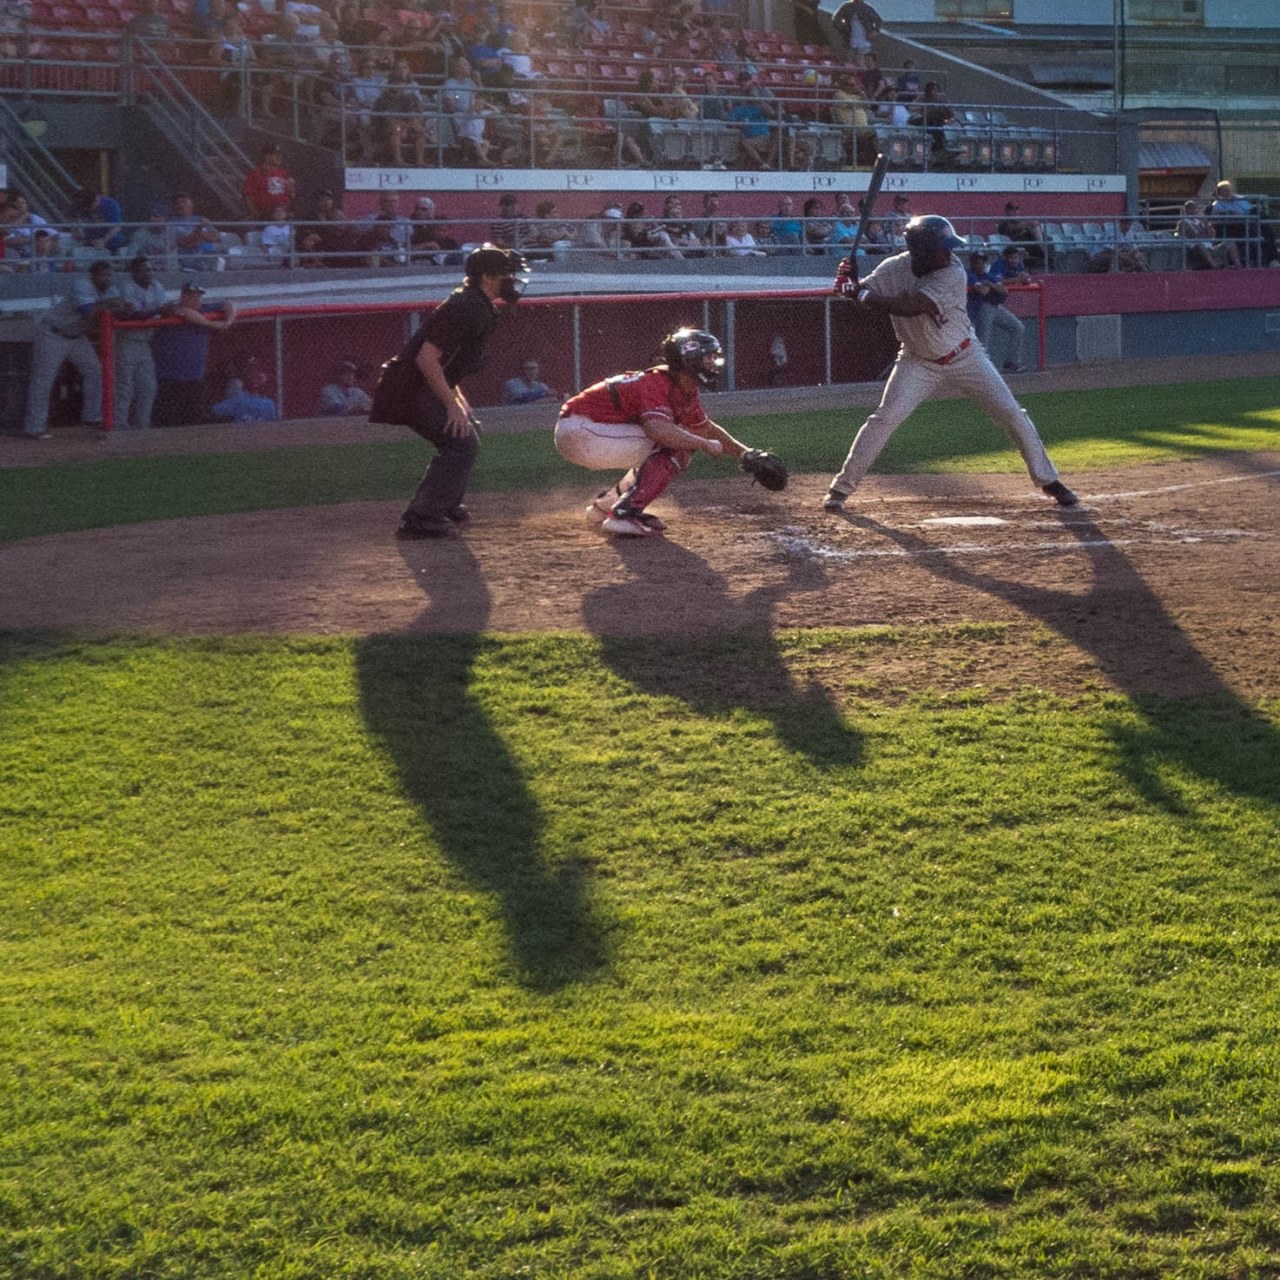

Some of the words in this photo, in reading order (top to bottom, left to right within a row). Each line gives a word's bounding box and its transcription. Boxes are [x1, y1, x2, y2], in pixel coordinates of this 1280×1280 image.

[379, 173, 408, 188] POP
[475, 174, 503, 188] POP
[566, 174, 594, 189] POP
[653, 174, 679, 189] POP
[734, 175, 760, 190] POP
[812, 176, 836, 190] POP
[886, 176, 908, 190] POP
[956, 177, 978, 191] POP
[1023, 177, 1043, 191] POP
[1086, 178, 1107, 192] POP
